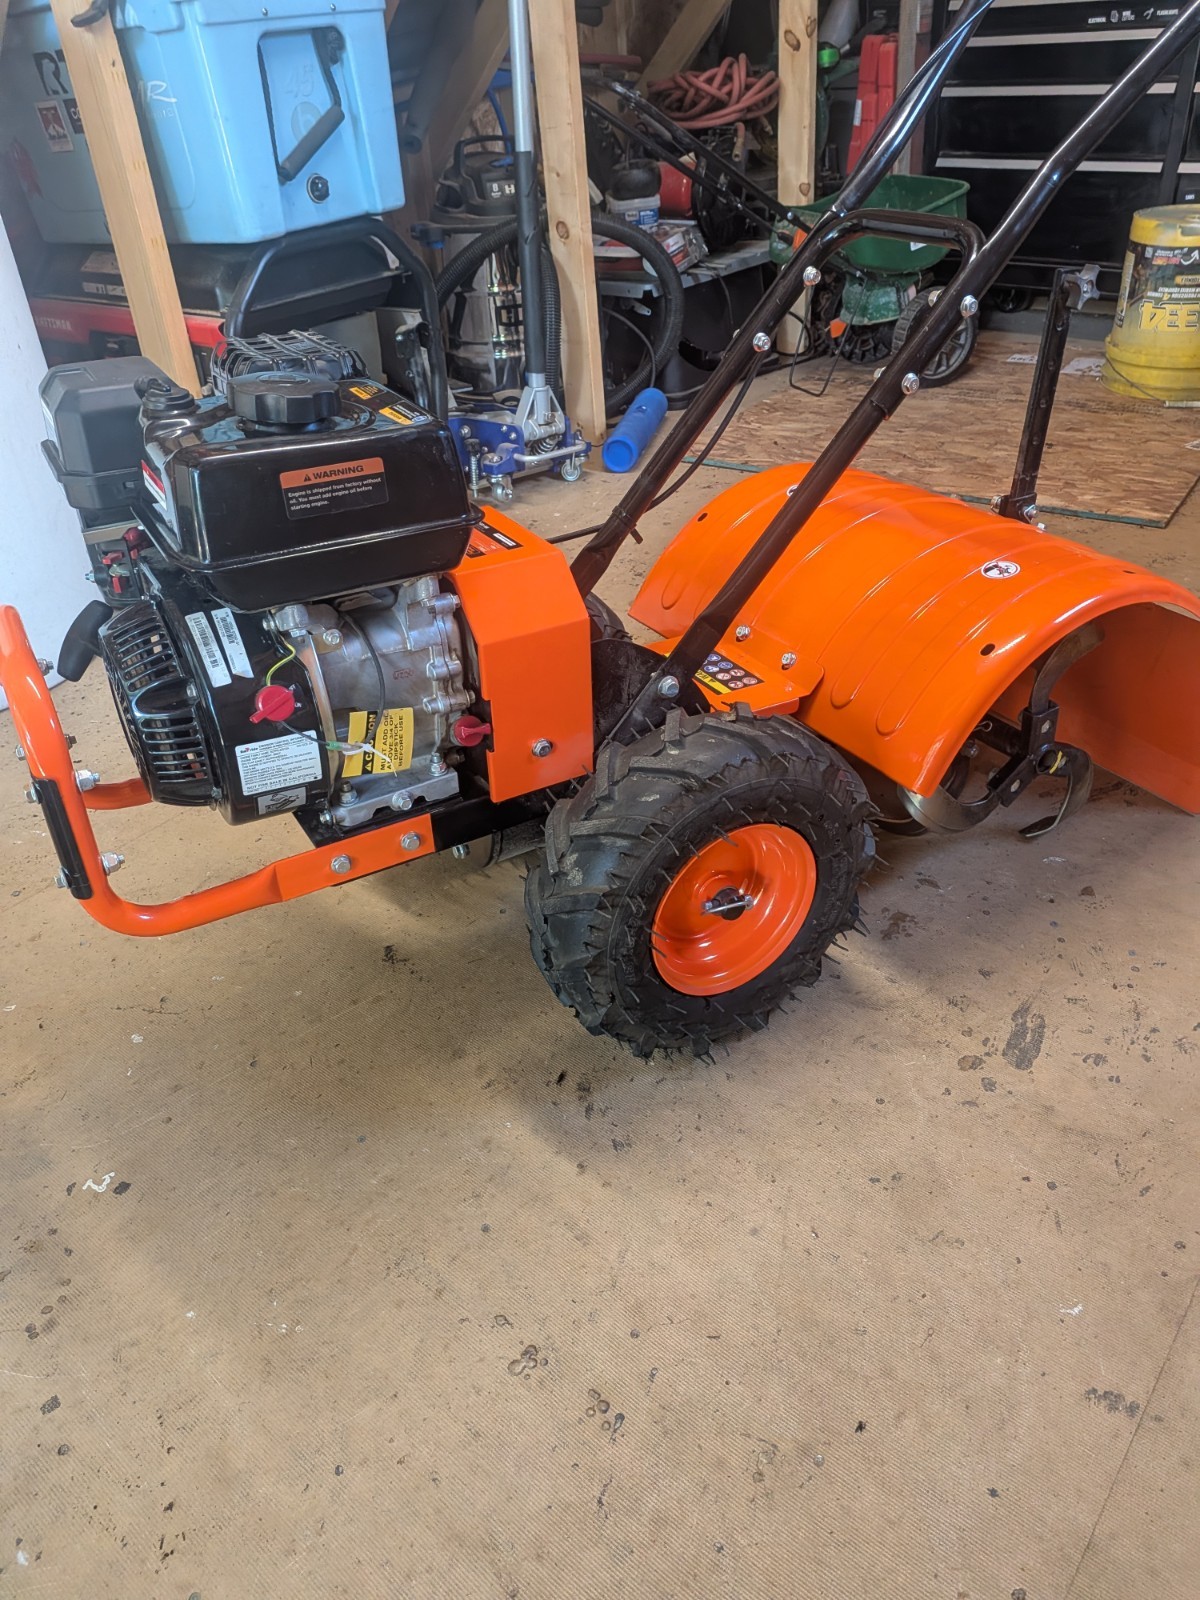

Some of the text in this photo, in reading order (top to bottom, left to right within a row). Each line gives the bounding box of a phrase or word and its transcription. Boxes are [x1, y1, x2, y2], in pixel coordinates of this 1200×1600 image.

[313, 465, 364, 480] WARNING
[312, 486, 332, 494] shipped
[345, 481, 362, 489] factory
[363, 477, 381, 485] without
[332, 489, 349, 497] engine
[291, 500, 329, 511] starting engine.
[389, 714, 394, 726] OF
